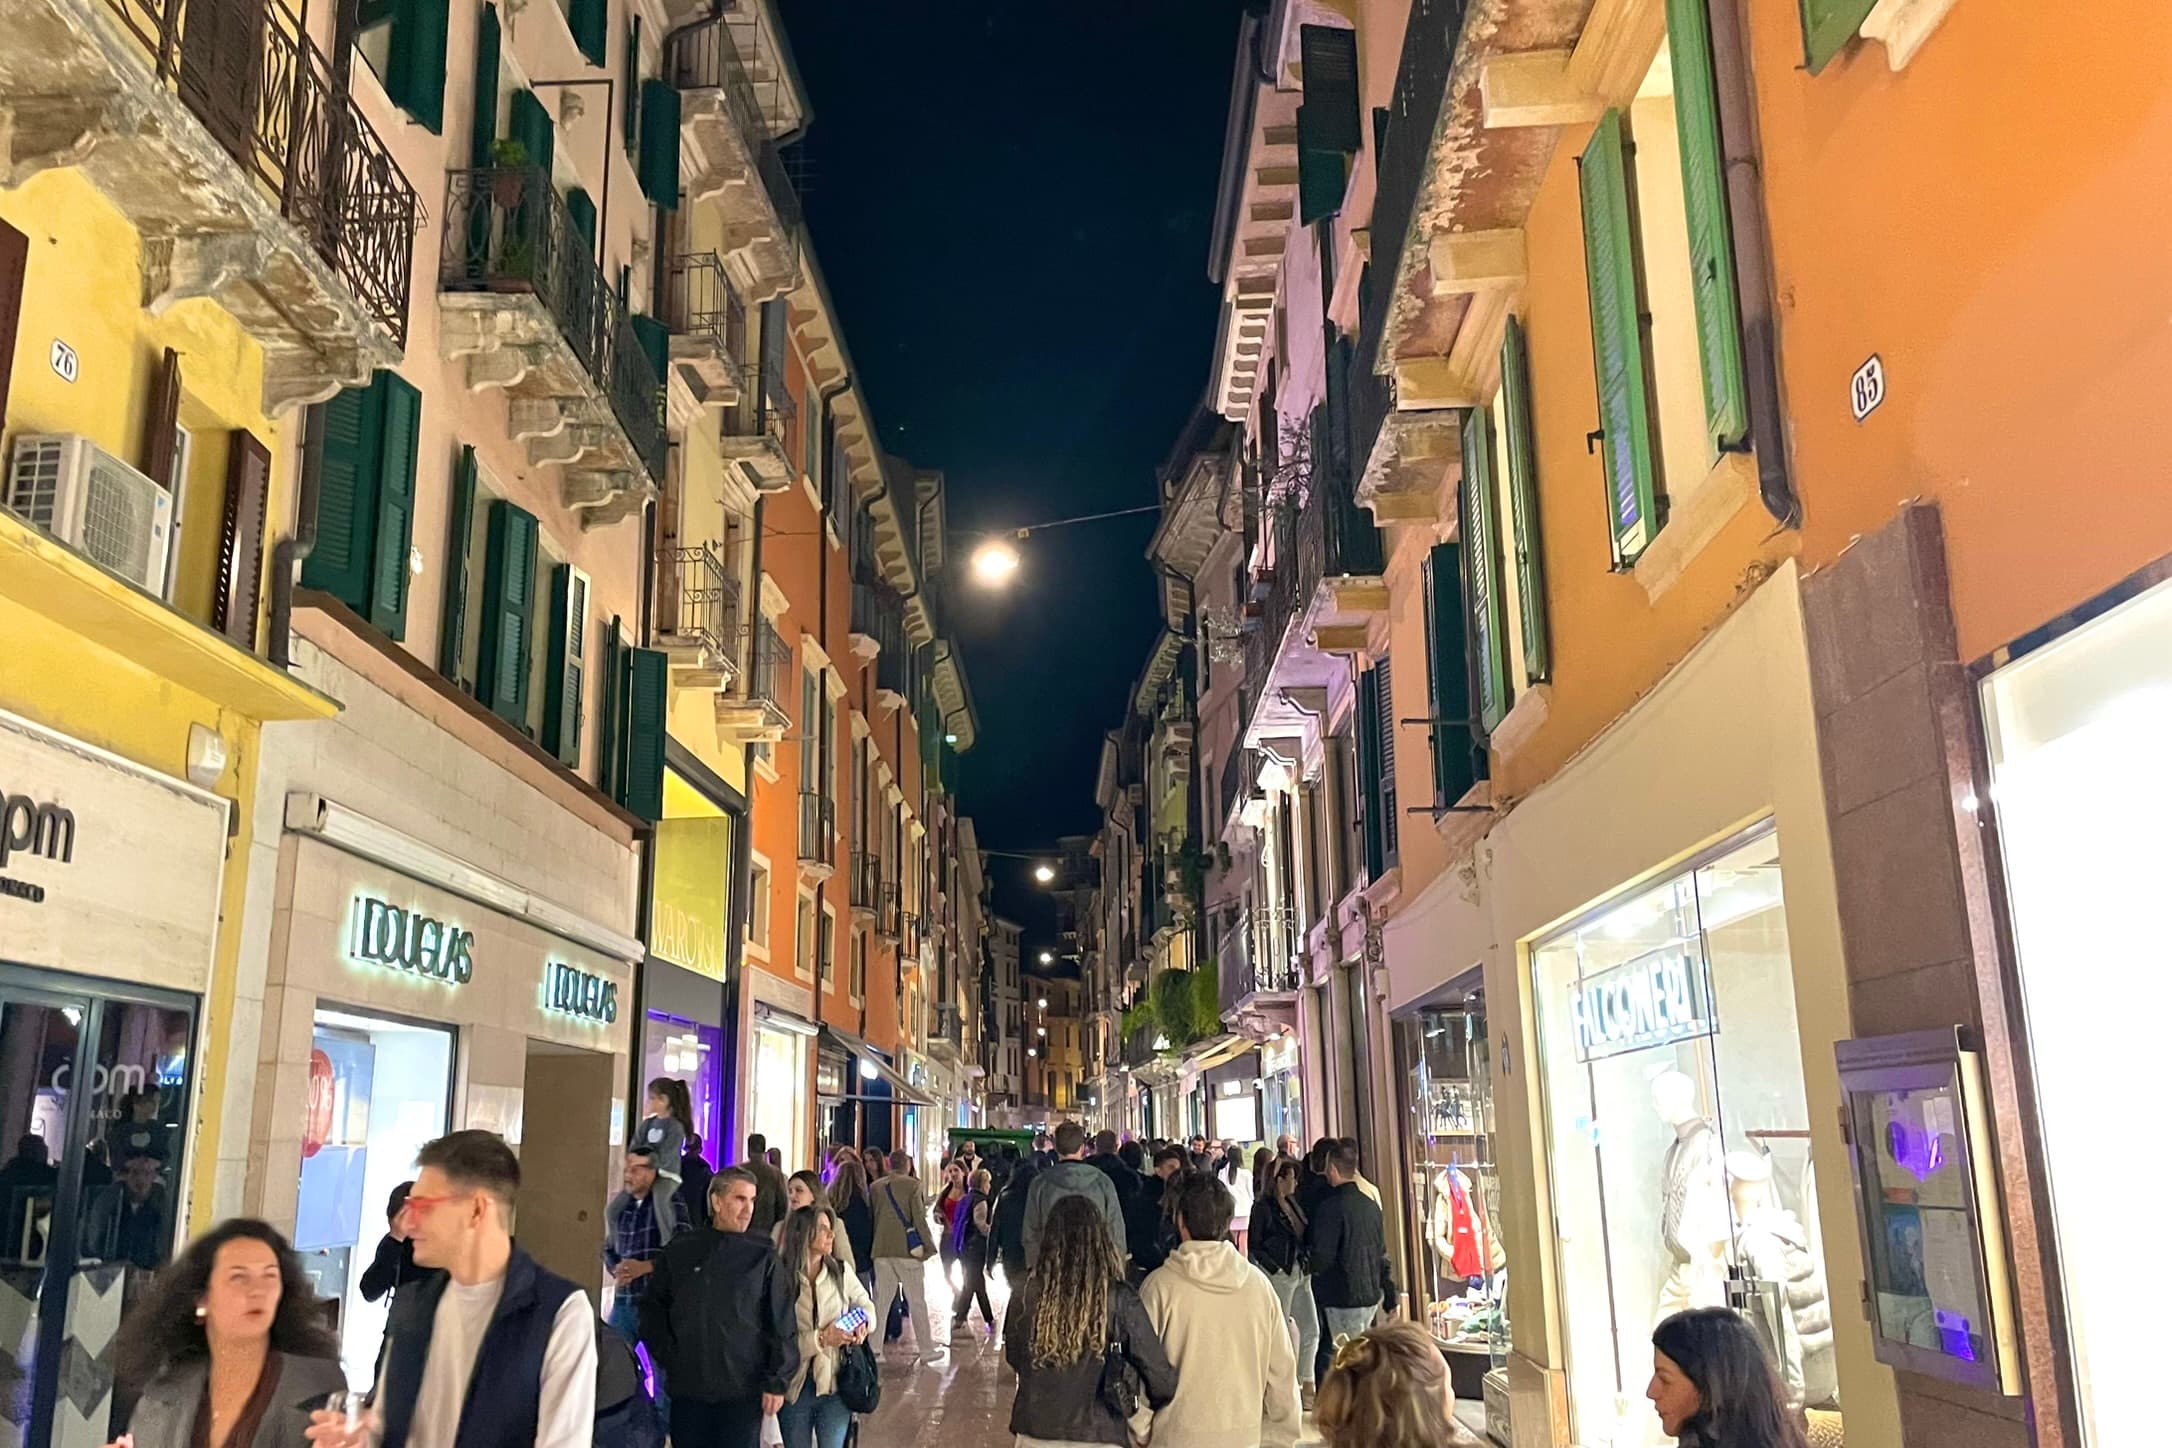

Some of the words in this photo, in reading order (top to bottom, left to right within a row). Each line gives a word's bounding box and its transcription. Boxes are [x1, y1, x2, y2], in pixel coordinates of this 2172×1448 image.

[56, 344, 73, 376] 76
[1856, 364, 1878, 412] 85
[0, 790, 75, 868] pm
